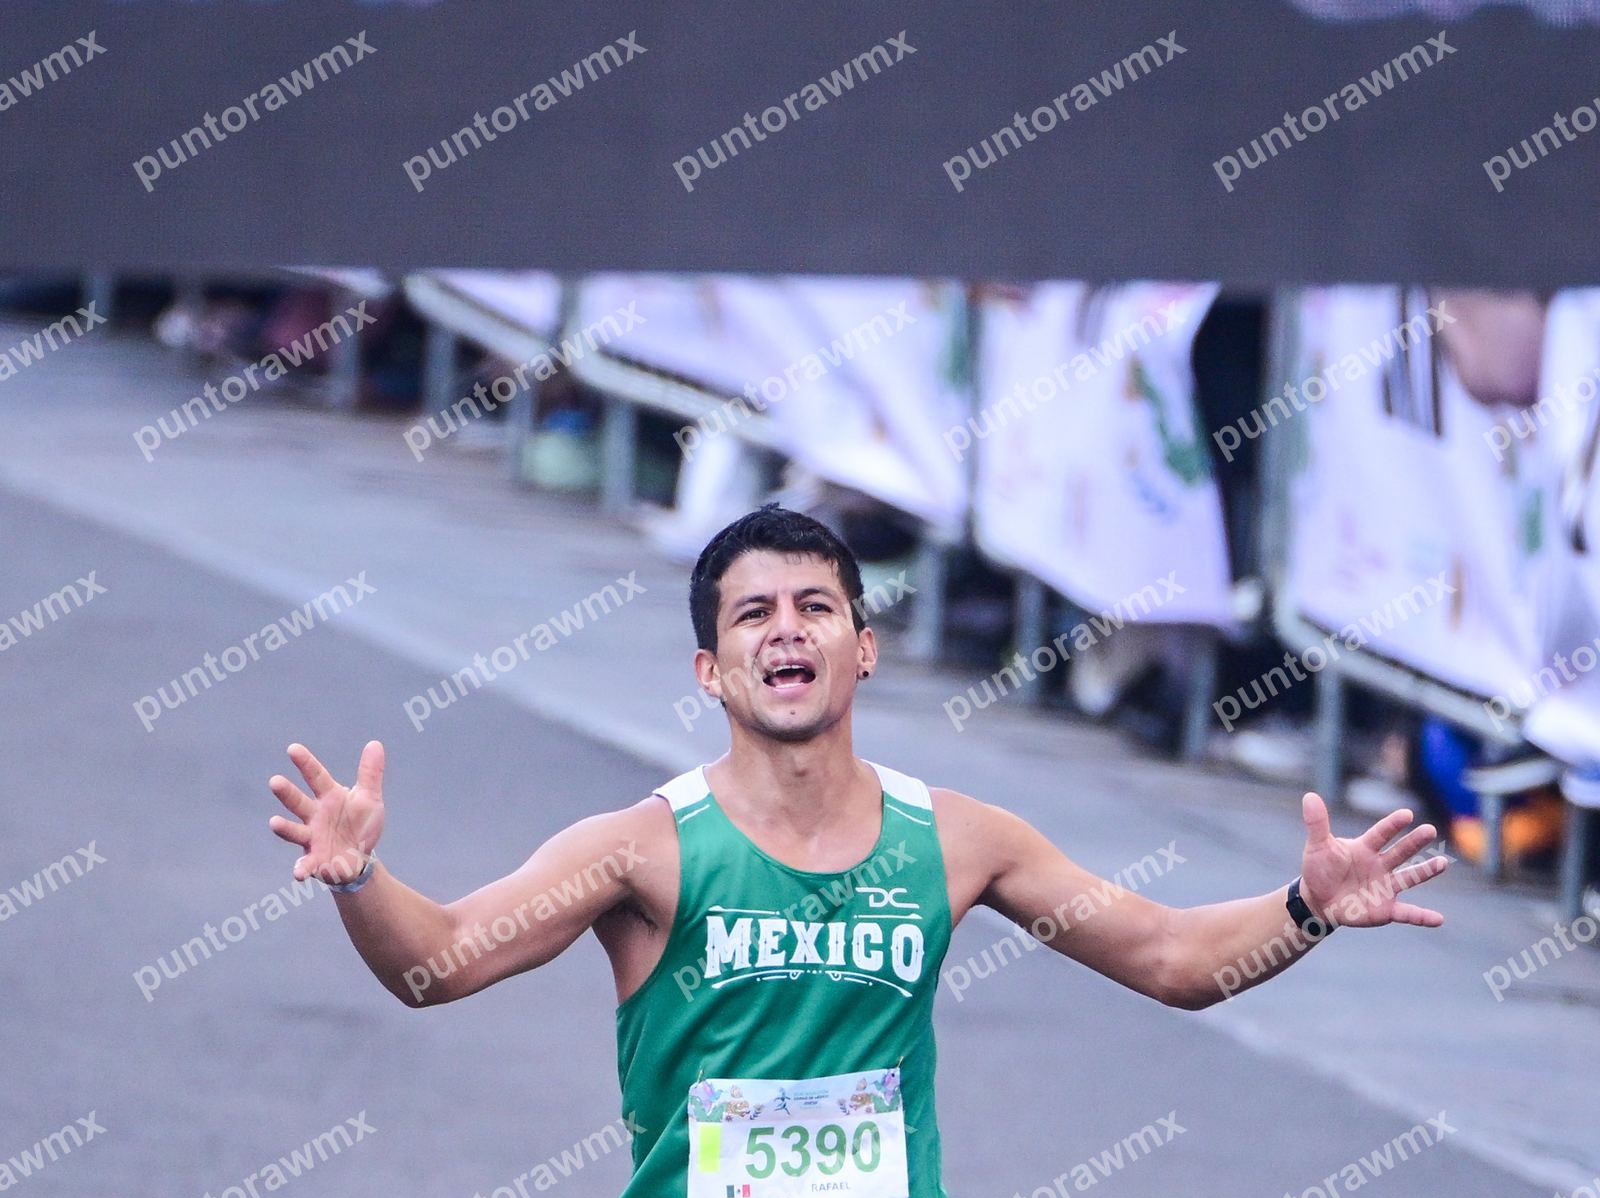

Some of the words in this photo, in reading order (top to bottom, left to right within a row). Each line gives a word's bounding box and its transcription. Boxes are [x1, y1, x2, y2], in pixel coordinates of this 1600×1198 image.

[704, 915, 924, 982] MEXICO
[745, 1120, 881, 1179] 5390
[811, 1182, 852, 1194] RAFAEL
